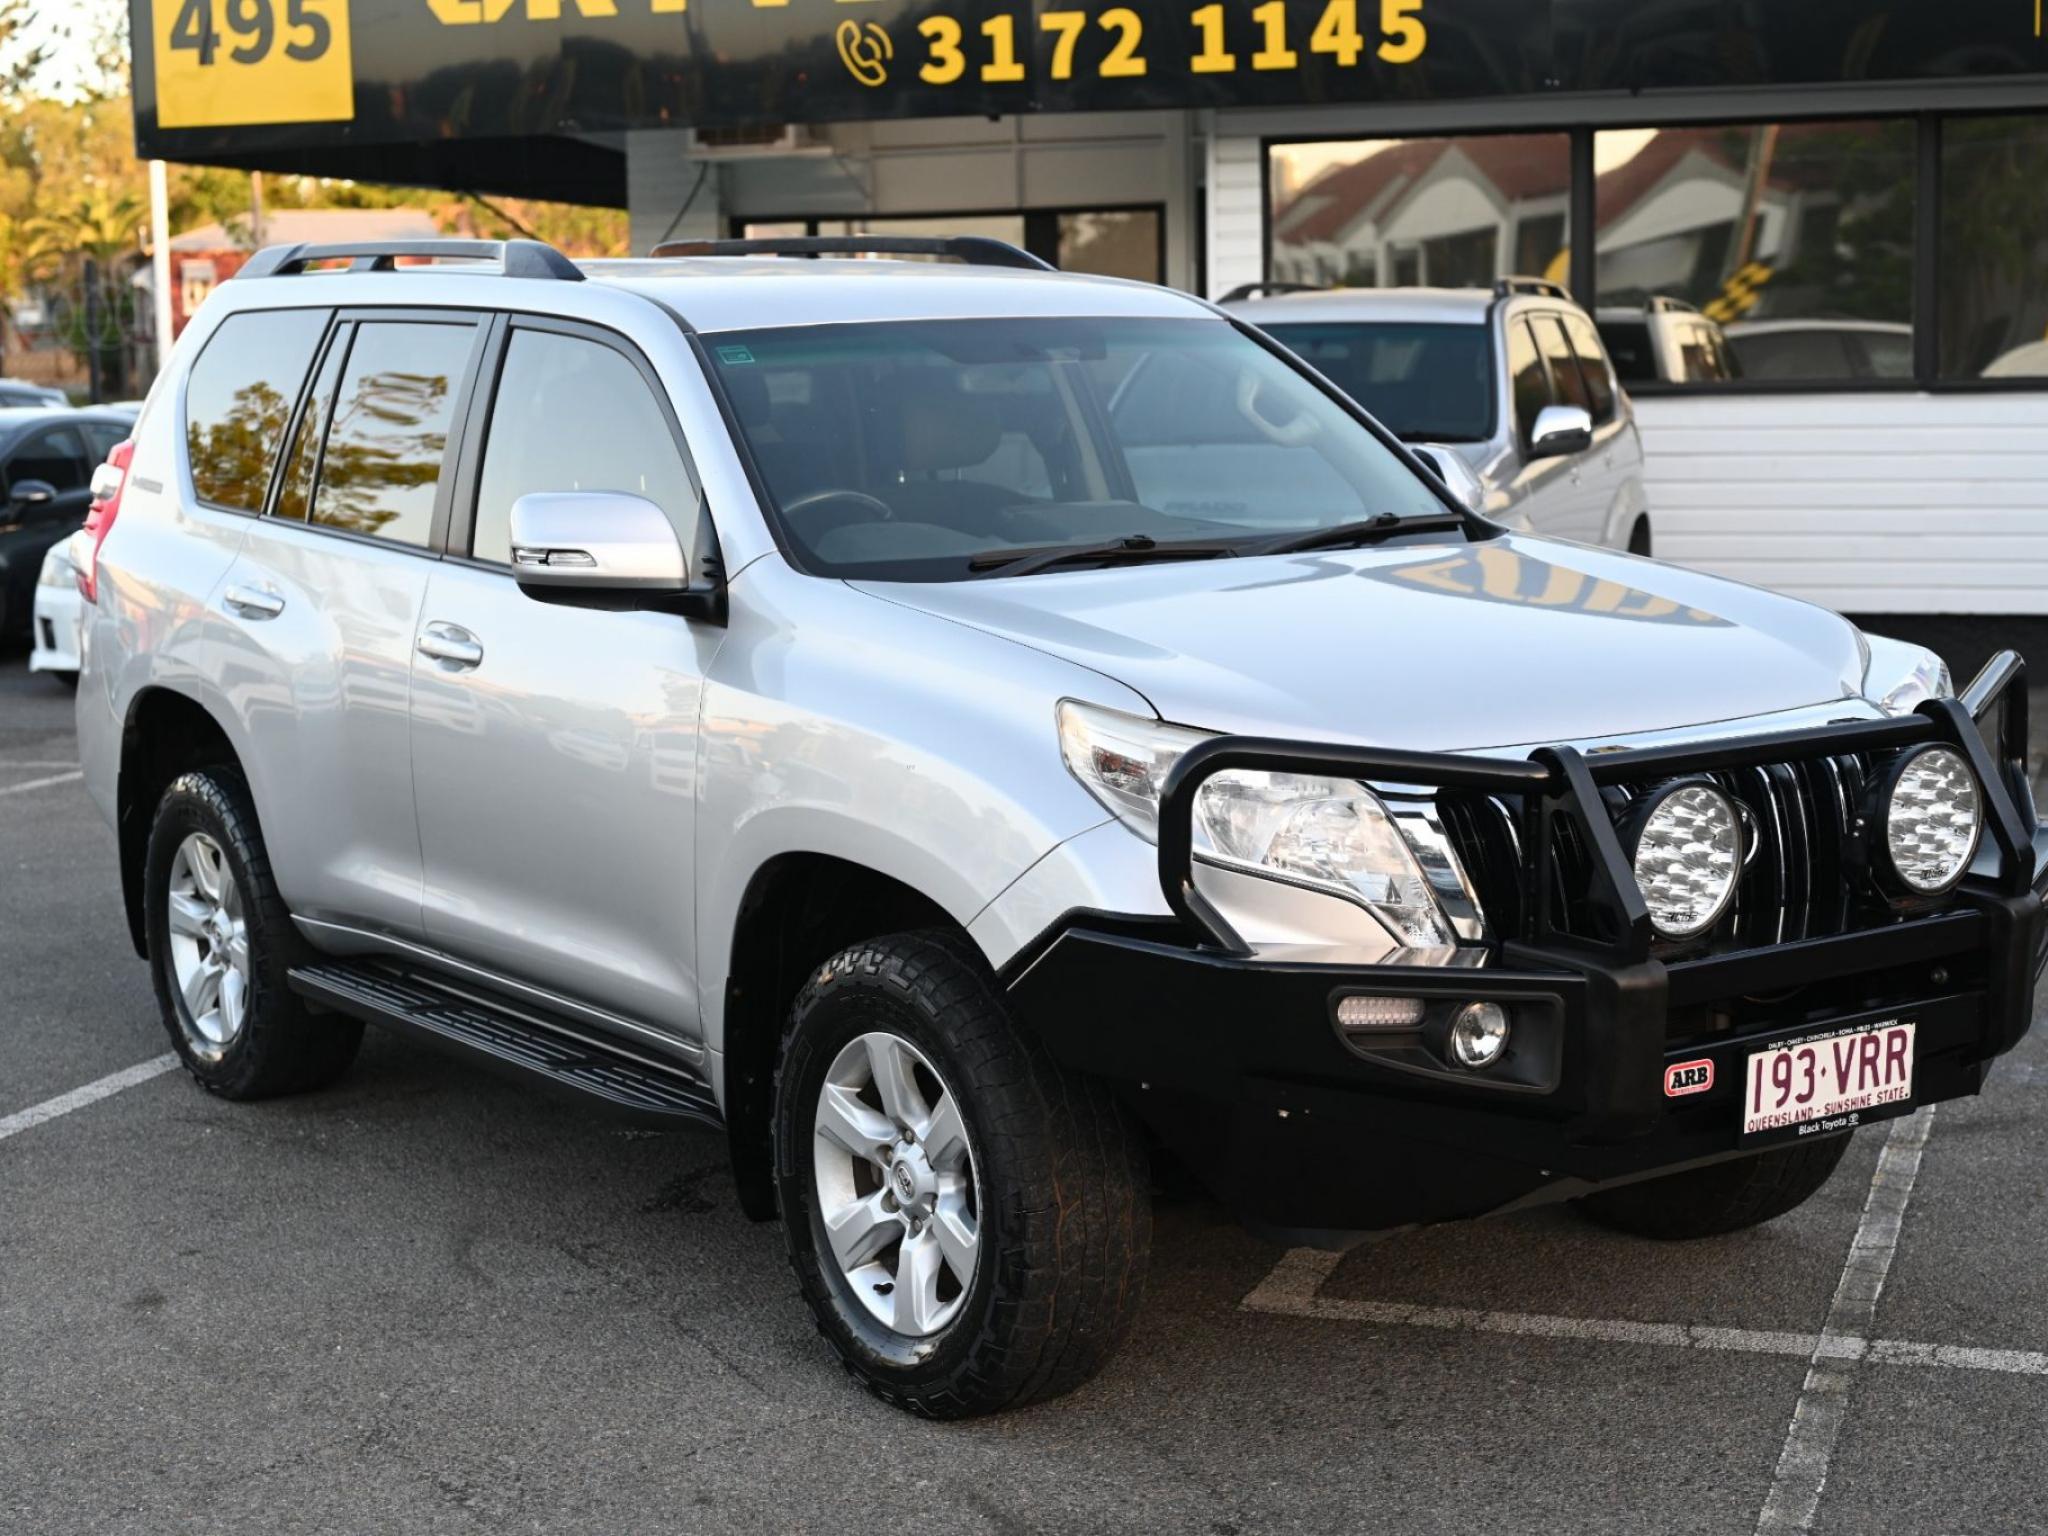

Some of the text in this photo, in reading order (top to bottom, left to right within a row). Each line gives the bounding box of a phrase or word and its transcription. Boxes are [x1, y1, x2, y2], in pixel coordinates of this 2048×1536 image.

[169, 0, 331, 66] 495
[918, 0, 1428, 85] 3172 1145
[1670, 1066, 1709, 1090] ARB
[1748, 1107, 1814, 1132] QUEENSLAND
[1824, 1094, 1872, 1115] SUNSHINE
[1799, 1118, 1847, 1136] Black Toyota
